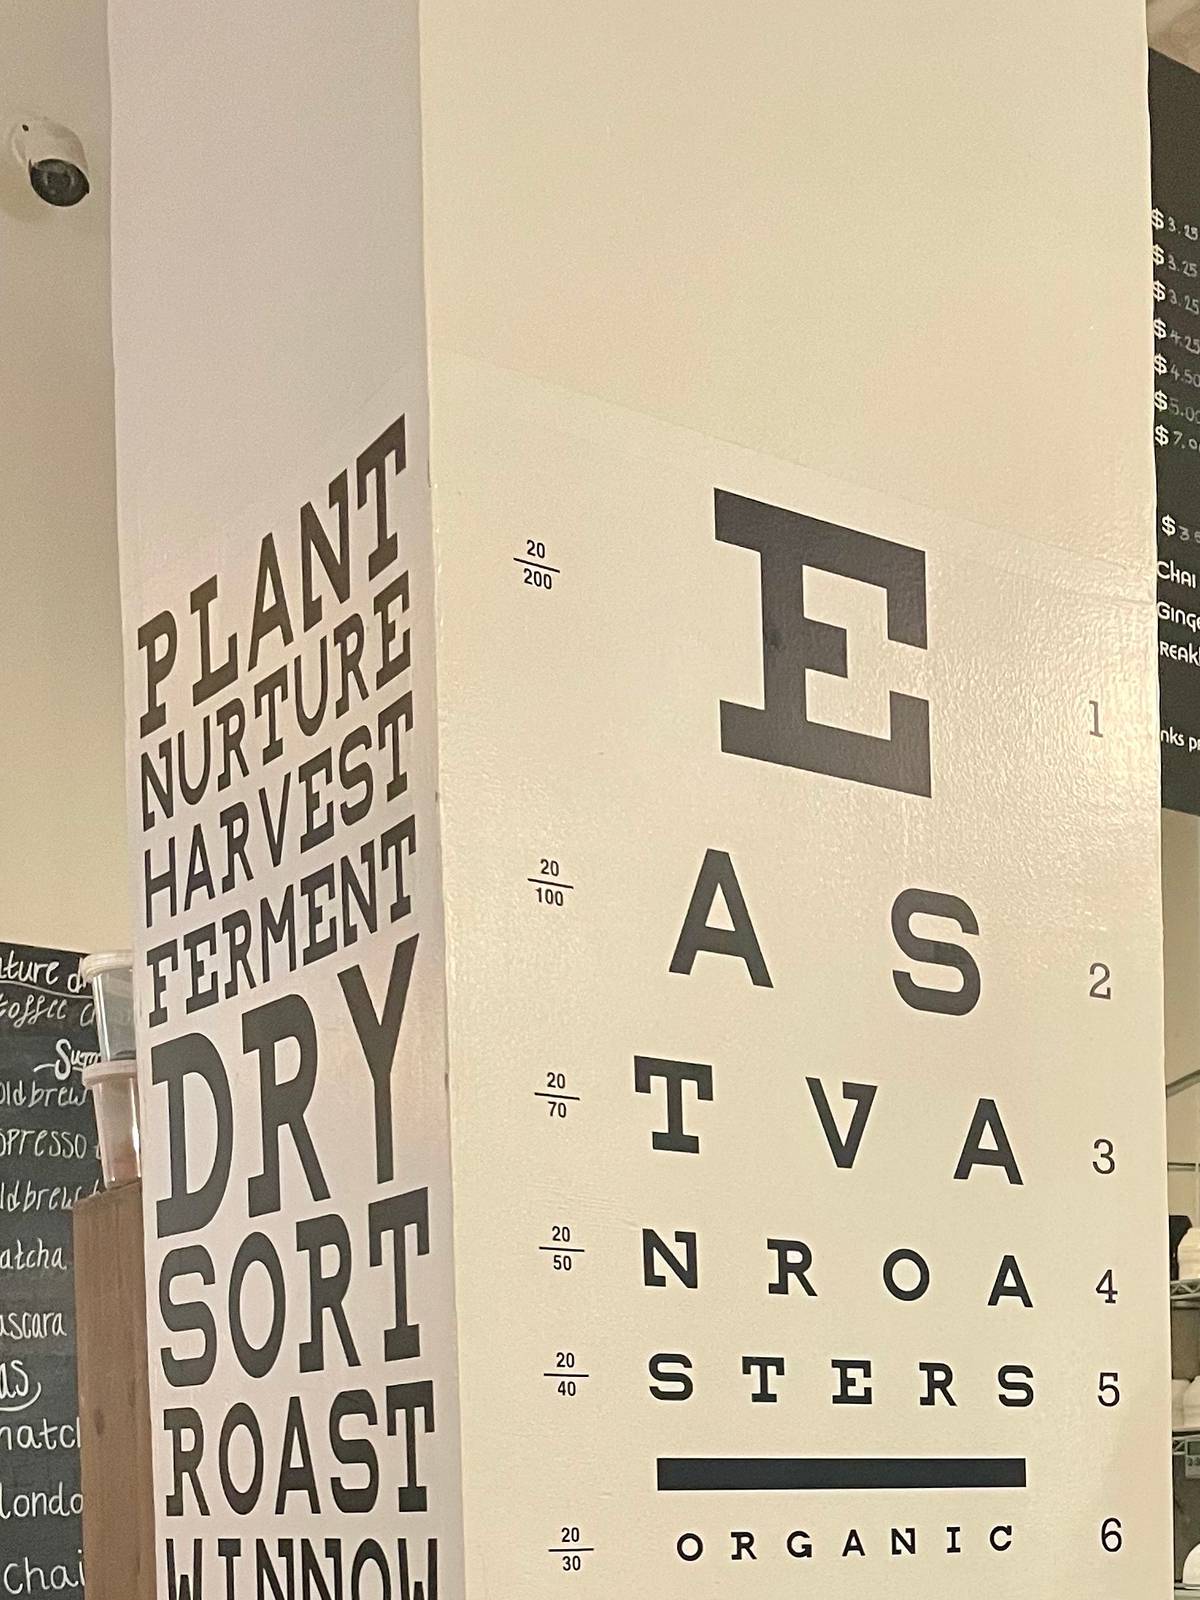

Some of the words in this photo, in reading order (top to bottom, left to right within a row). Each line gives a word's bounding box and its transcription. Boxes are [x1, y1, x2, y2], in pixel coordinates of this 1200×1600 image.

[526, 539, 546, 559] 20
[138, 414, 407, 739] PLANT
[523, 567, 553, 590] 200
[714, 487, 932, 799] E
[141, 570, 411, 832] NURTURE
[1089, 700, 1103, 738] 1
[145, 691, 414, 928] HARVEST
[540, 858, 560, 877] 20
[535, 887, 564, 907] 100
[147, 814, 417, 1028] FERMENT
[1089, 963, 1111, 1000] 2
[151, 933, 420, 1239] DRY
[546, 1071, 566, 1090] 20
[547, 1101, 567, 1119] 70
[1092, 1138, 1115, 1175] 3
[551, 1225, 571, 1243] 20
[553, 1254, 572, 1271] 50
[159, 1187, 430, 1388] SORT
[1096, 1269, 1118, 1304] 4
[555, 1351, 575, 1369] 20
[557, 1380, 577, 1397] 40
[1098, 1372, 1120, 1407] 5
[164, 1380, 436, 1517] ROAST
[561, 1526, 580, 1543] 20
[1101, 1517, 1122, 1553] 6
[562, 1555, 581, 1572] 30
